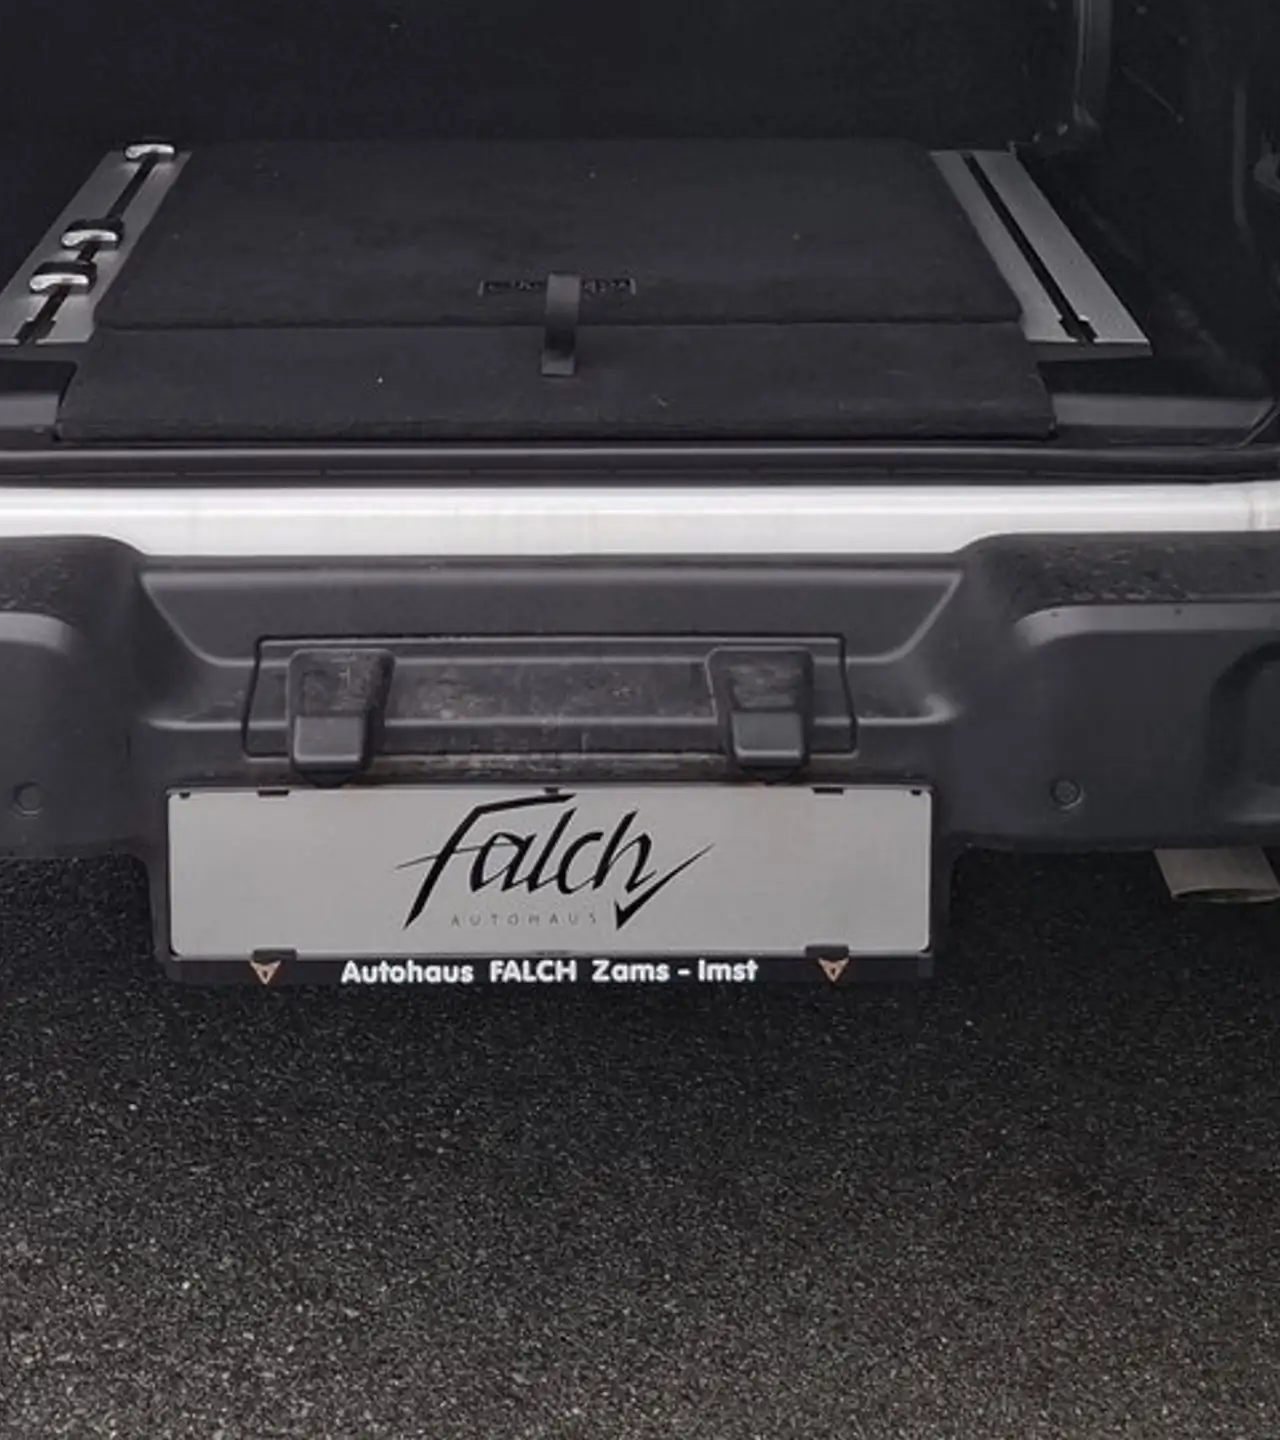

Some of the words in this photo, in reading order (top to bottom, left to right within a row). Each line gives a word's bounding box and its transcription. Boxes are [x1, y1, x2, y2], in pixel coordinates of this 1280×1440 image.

[450, 911, 598, 927] AUTOHAUS
[340, 959, 474, 984] Autohaus
[489, 960, 577, 983] FALCH
[591, 960, 670, 982] Zams
[697, 960, 758, 982] Imst
